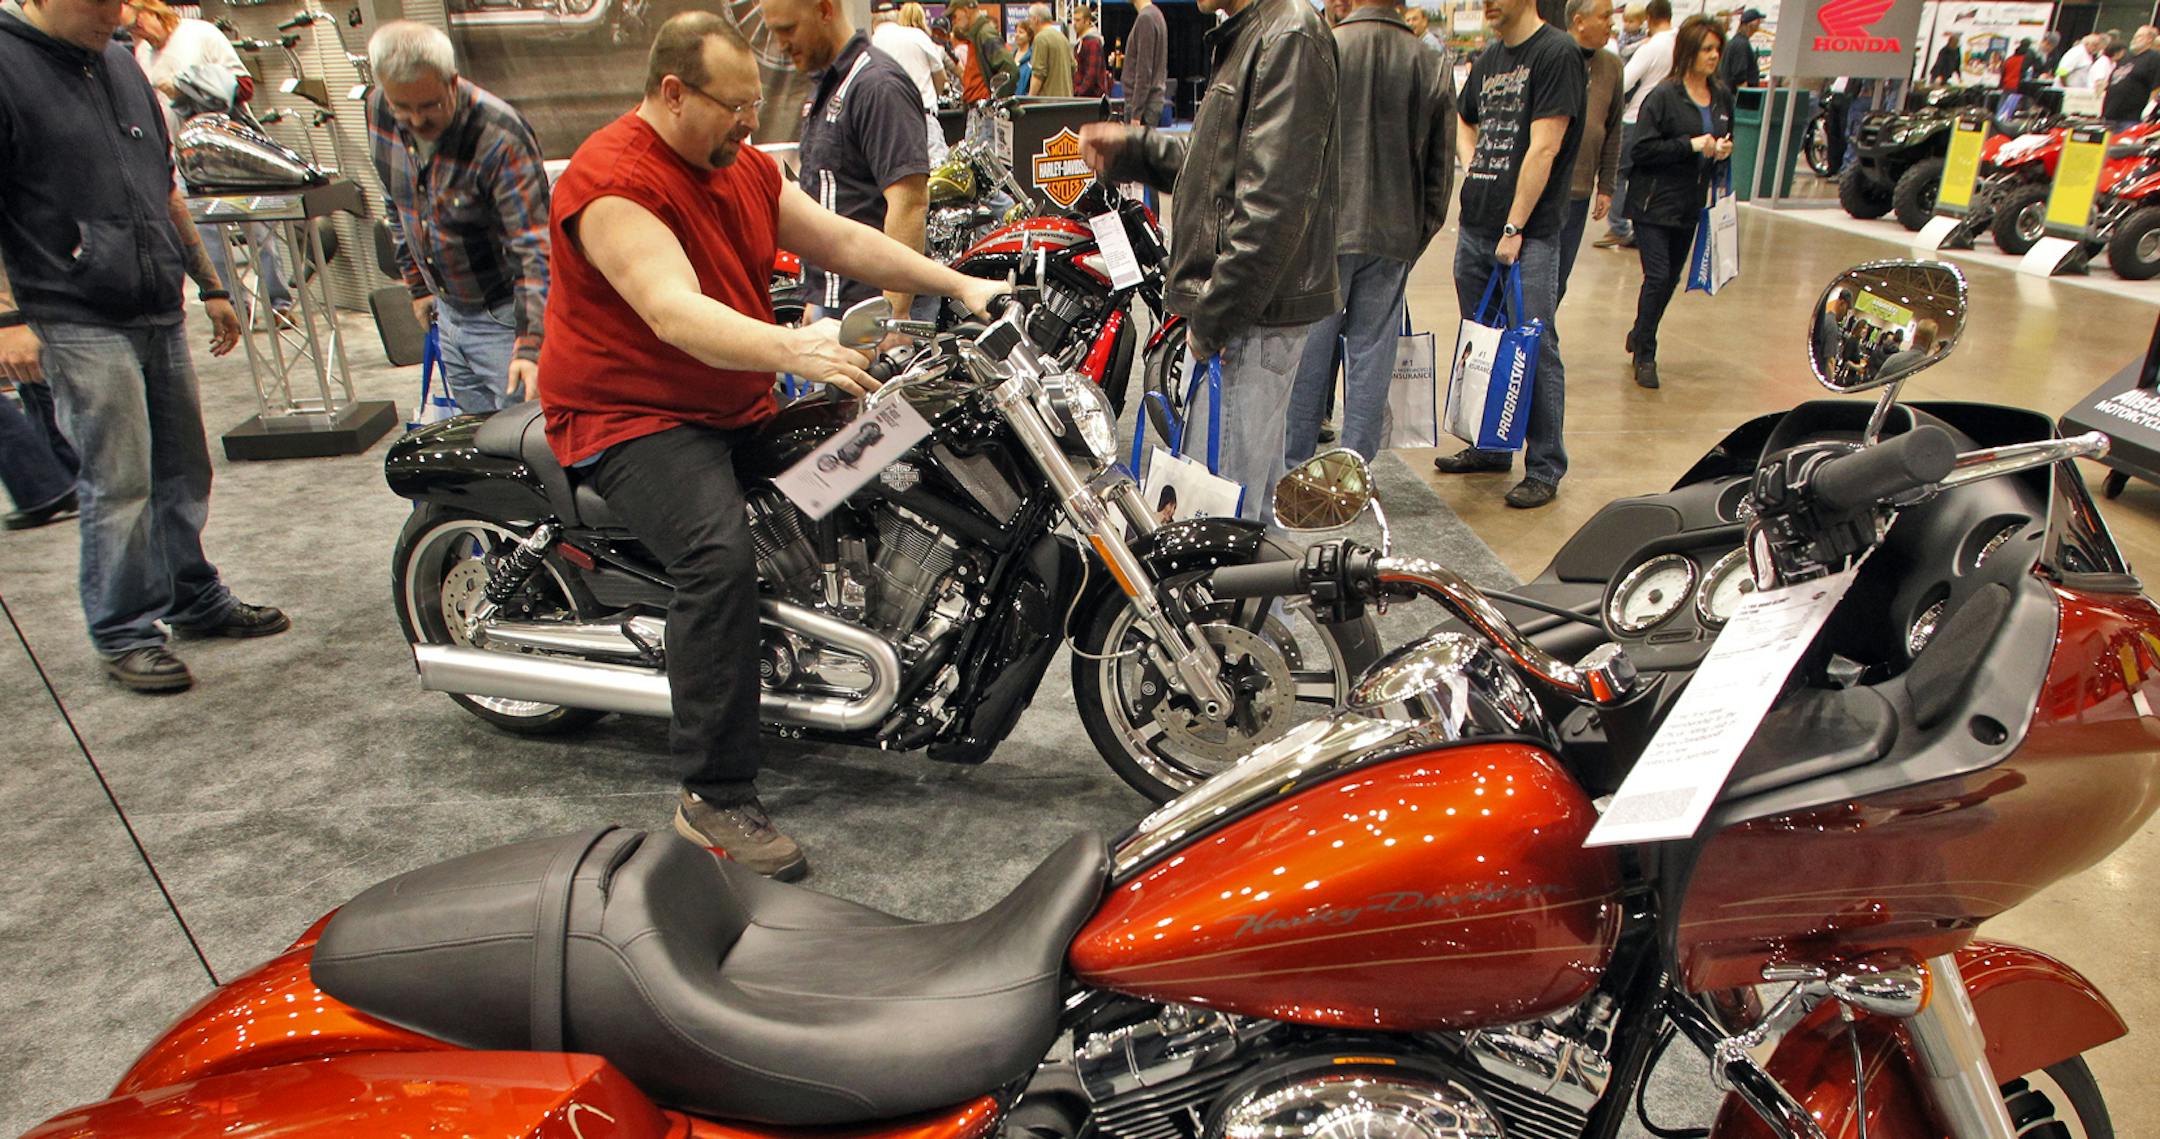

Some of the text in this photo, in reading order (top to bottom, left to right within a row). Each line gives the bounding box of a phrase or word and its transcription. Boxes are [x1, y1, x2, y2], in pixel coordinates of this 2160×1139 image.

[1811, 36, 1902, 53] HONDA
[1051, 179, 1082, 197] CYCLES
[1497, 346, 1527, 441] PROGRESSIVE
